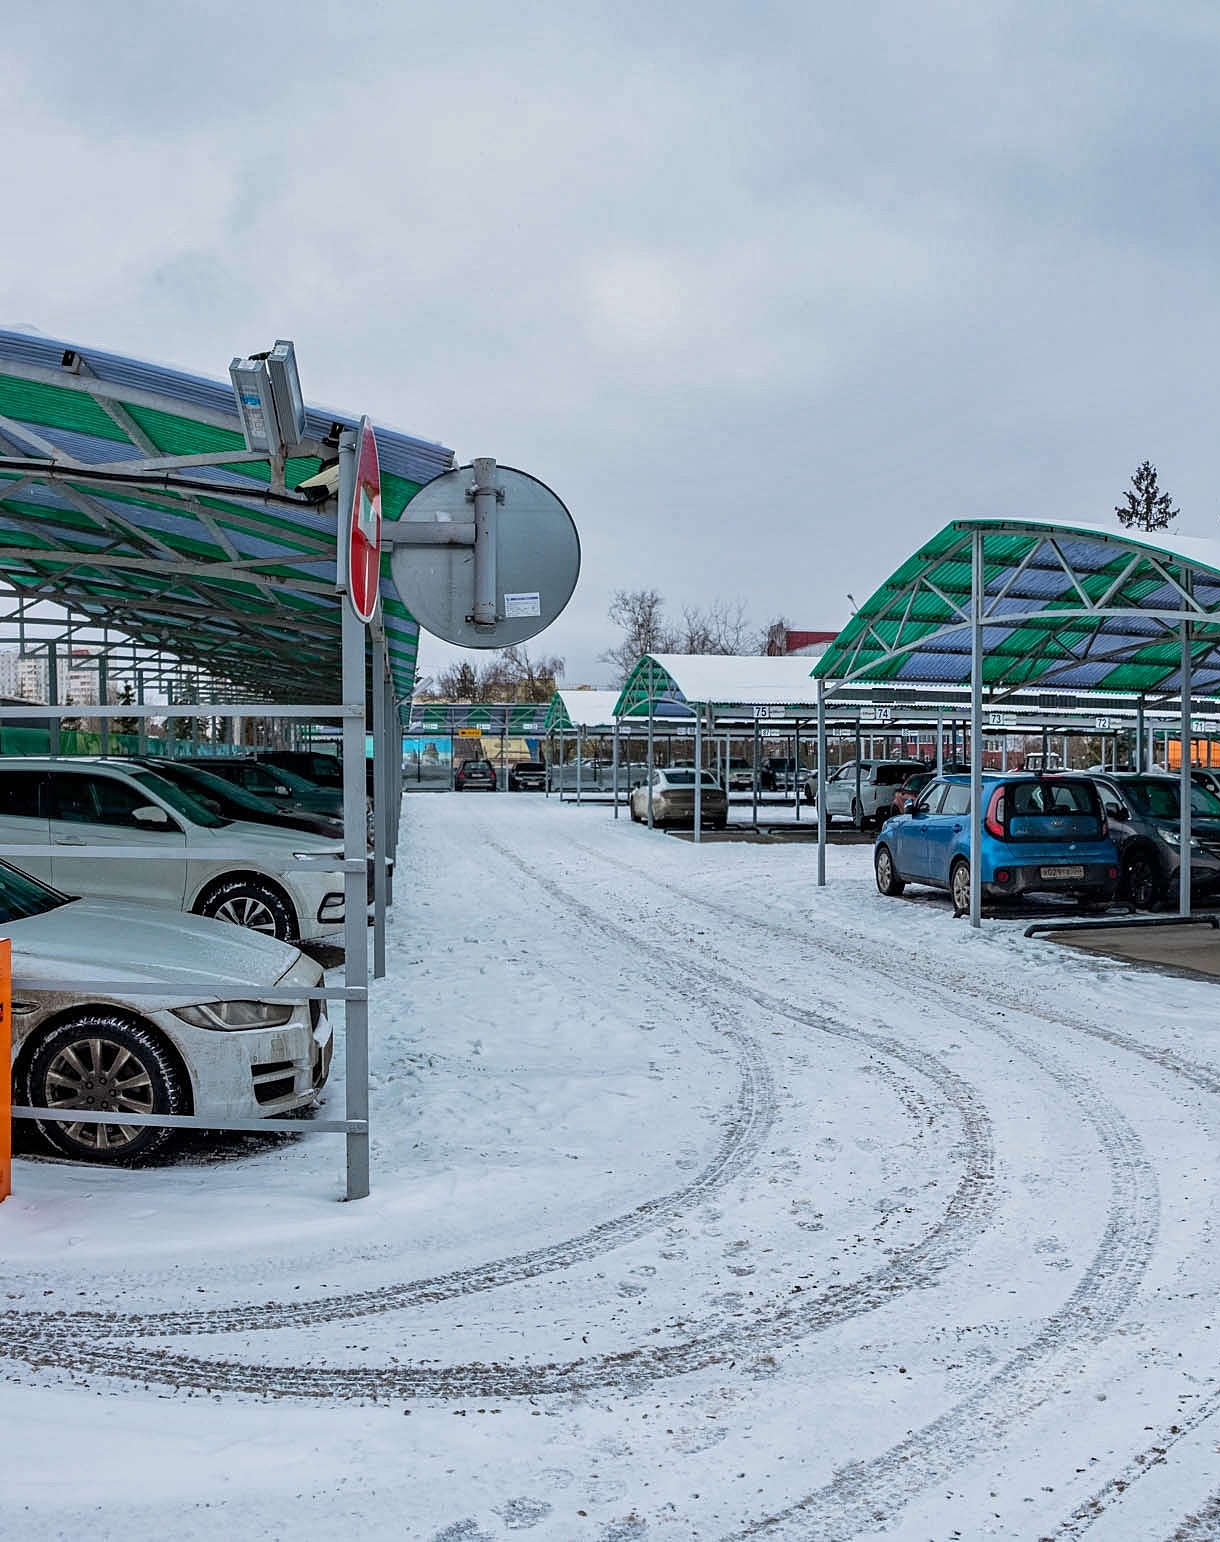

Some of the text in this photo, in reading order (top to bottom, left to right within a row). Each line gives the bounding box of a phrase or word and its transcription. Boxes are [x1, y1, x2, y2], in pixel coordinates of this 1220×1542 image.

[755, 706, 767, 717] 75
[877, 708, 889, 719] 74
[991, 714, 1002, 724] 73
[1097, 718, 1107, 728] 72
[1193, 722, 1205, 731] 71
